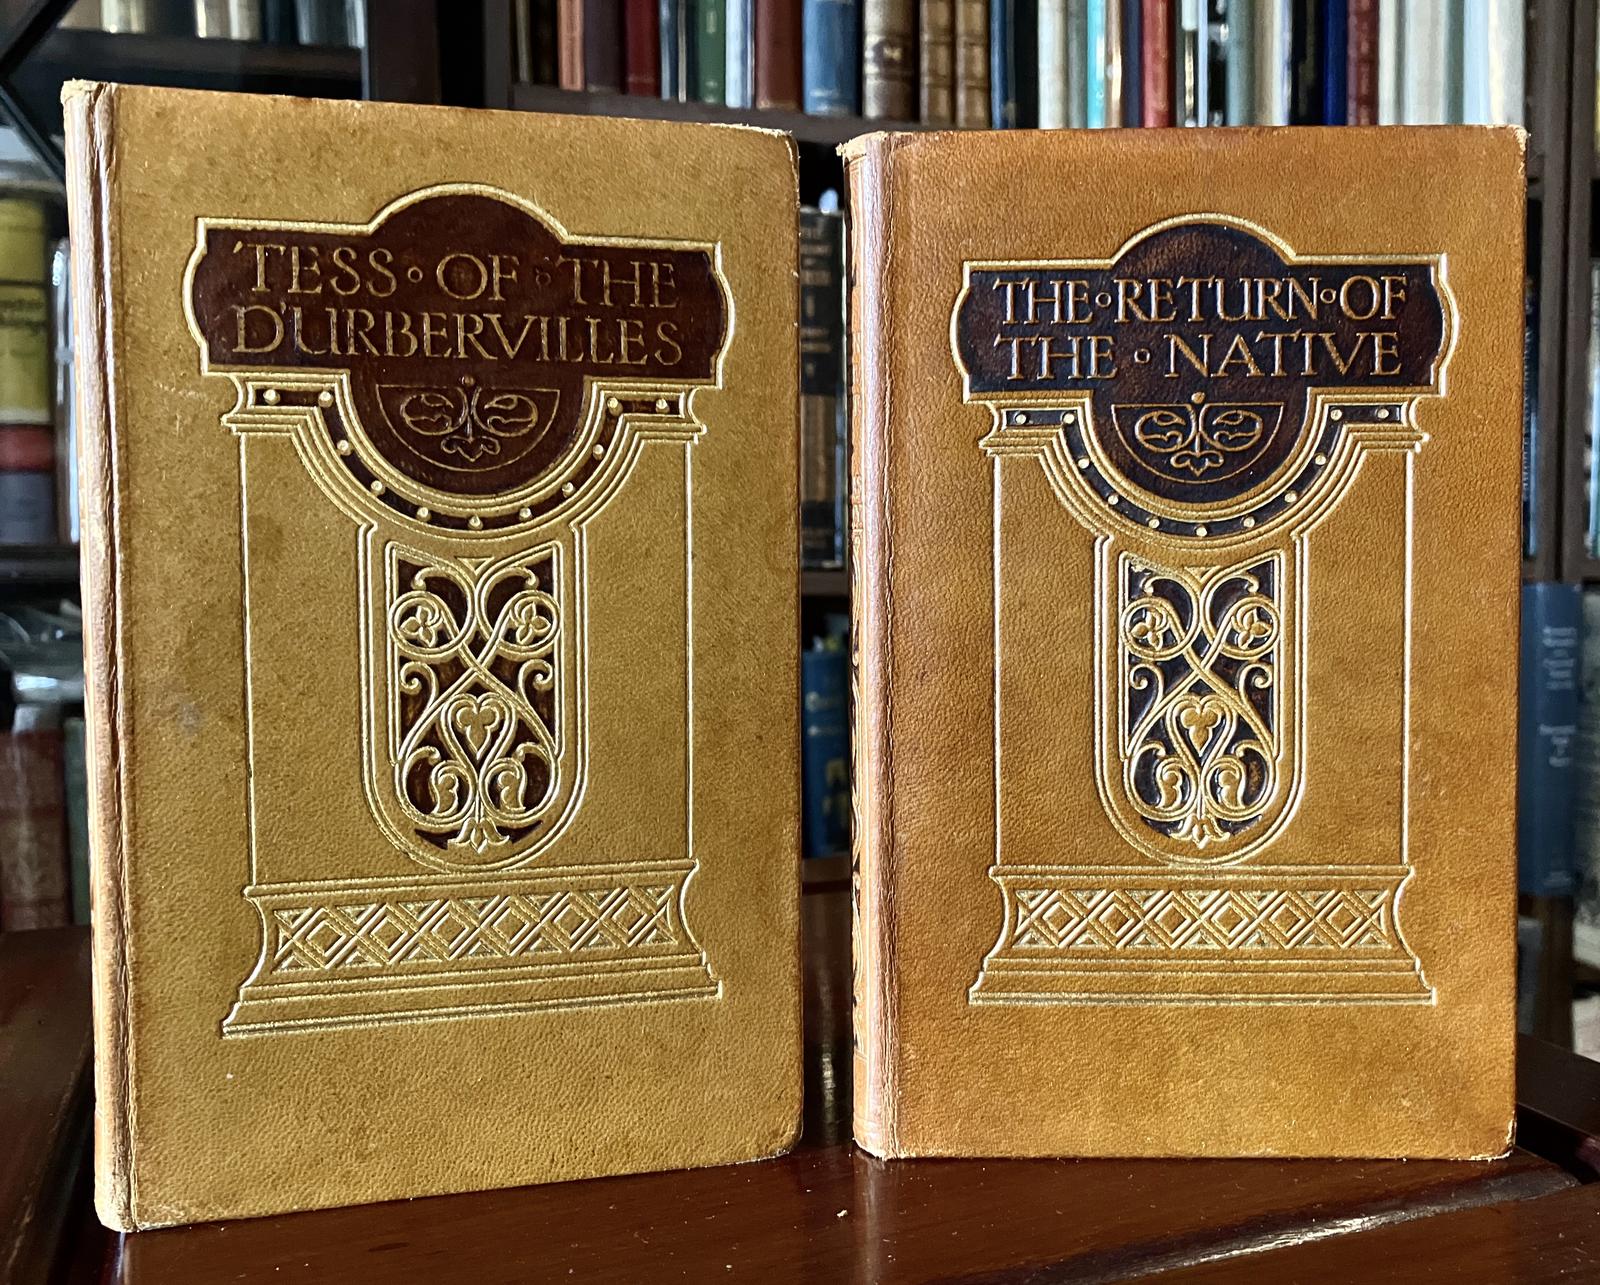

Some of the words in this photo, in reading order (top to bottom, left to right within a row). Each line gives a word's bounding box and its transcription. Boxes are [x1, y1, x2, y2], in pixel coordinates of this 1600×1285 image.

[436, 253, 520, 301] OF
[555, 254, 677, 308] THE
[992, 277, 1094, 325] THE
[1112, 275, 1322, 323] RETURN
[1339, 274, 1407, 321] OF
[232, 301, 683, 366] D'URBERVILLES
[993, 333, 1118, 380] THE
[1163, 329, 1402, 378] NATIVE
